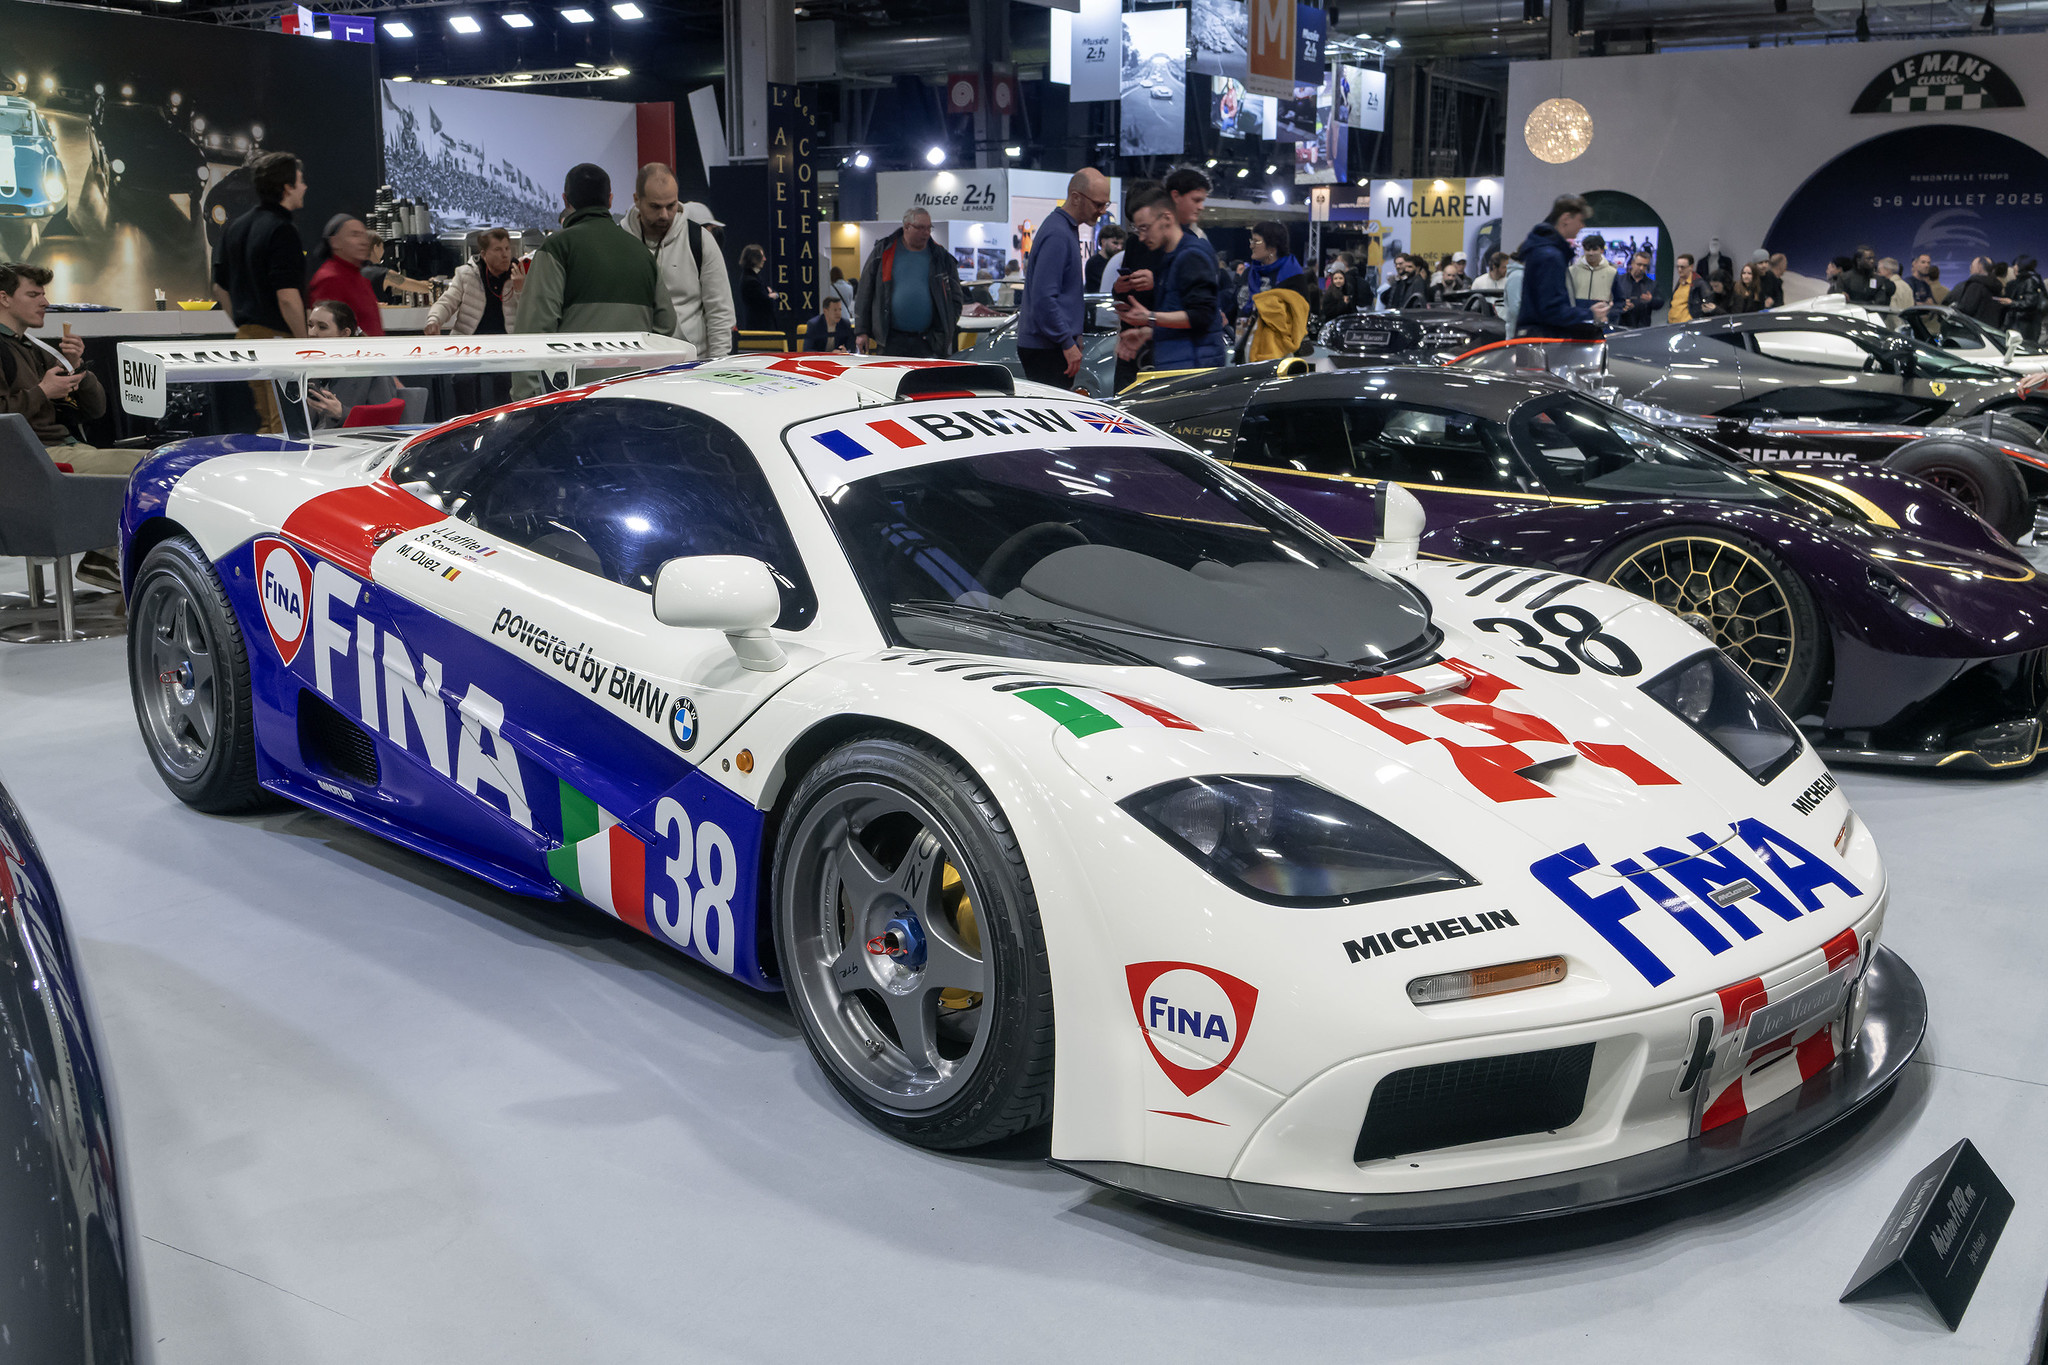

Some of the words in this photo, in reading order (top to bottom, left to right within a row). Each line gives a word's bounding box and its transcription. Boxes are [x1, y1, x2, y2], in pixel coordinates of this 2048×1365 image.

[1891, 59, 1917, 85] LE
[1920, 53, 1992, 82] MANS
[1917, 74, 1960, 86] CLASSIC
[914, 191, 959, 206] Musée
[963, 184, 996, 205] 24h
[1387, 195, 1491, 218] McLAREN
[1912, 193, 1987, 207] JUILLET
[1995, 193, 2044, 206] 2025
[798, 138, 813, 310] COTEAUX
[295, 349, 386, 361] Radio
[444, 345, 526, 357] Mans
[123, 359, 157, 391] BMW
[124, 390, 144, 404] France
[908, 408, 1078, 442] BMW
[1173, 426, 1233, 438] ANEMOS
[1738, 448, 1858, 463] SIEMENS
[442, 530, 481, 551] Laffite
[396, 544, 413, 558] M.
[410, 550, 441, 572] Duez
[264, 570, 302, 620] FINA
[1472, 604, 1643, 677] 38
[491, 606, 586, 674] powered
[579, 641, 609, 694] by
[607, 662, 670, 725] BMW
[313, 561, 533, 830] FINA
[1791, 771, 1838, 817] MICHELIN
[652, 796, 737, 975] 38
[1529, 817, 1865, 988] FINA
[1342, 908, 1521, 964] MICHELIN
[1149, 995, 1230, 1044] FINA
[1757, 1015, 1784, 1040] Joe
[1787, 981, 1834, 1025] Macari
